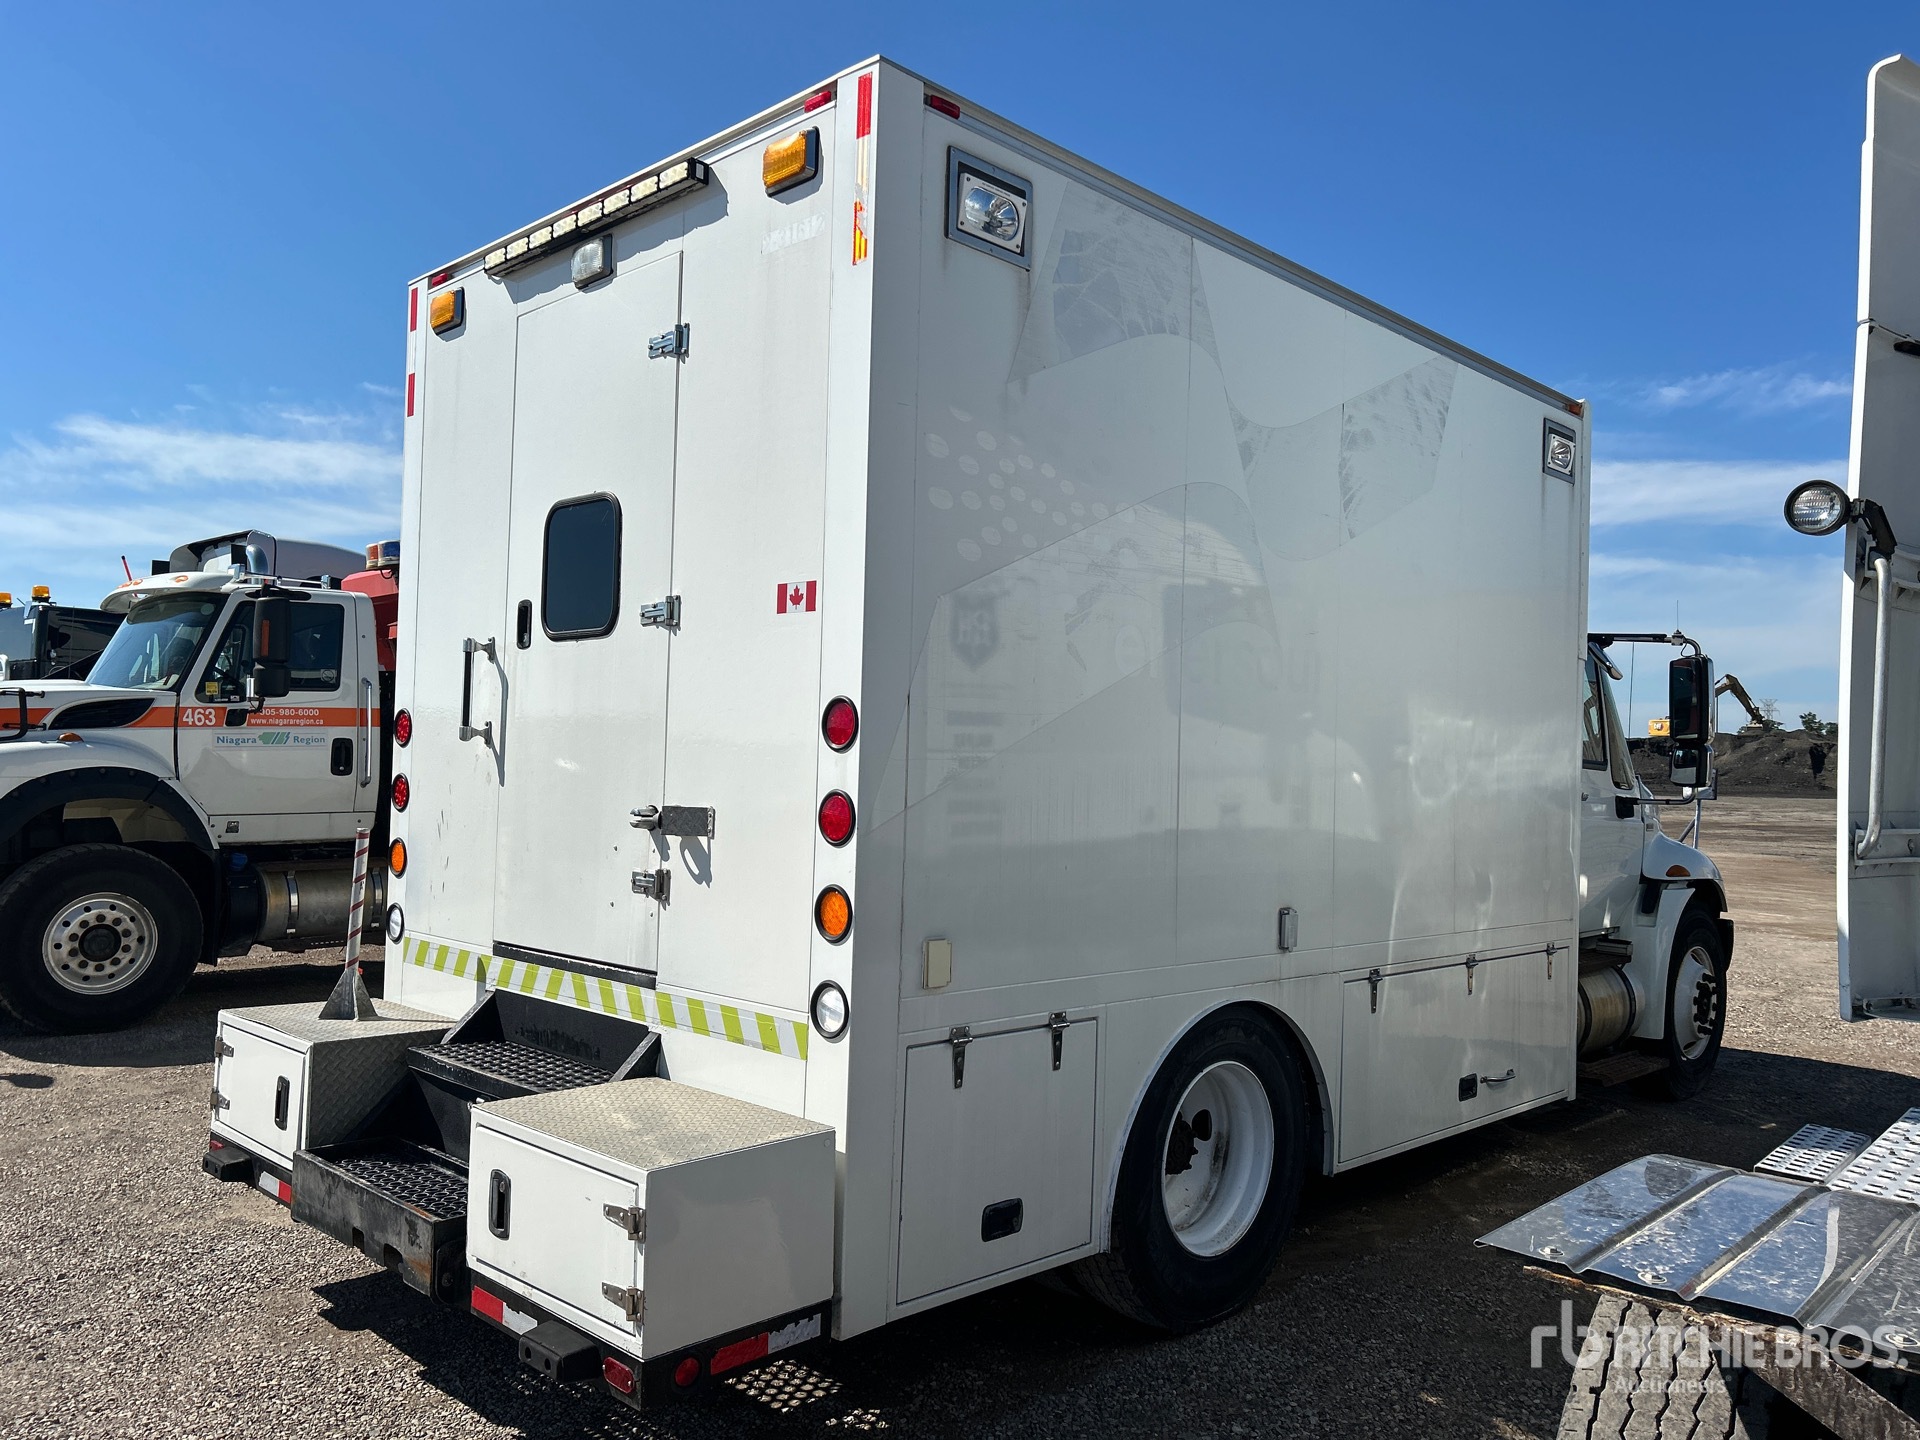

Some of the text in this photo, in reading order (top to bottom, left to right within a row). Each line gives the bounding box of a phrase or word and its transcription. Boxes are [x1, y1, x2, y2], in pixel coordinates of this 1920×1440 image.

[182, 708, 216, 726] 463
[250, 717, 324, 726] www.niagararegion.ca
[216, 736, 326, 746] Niagara Region
